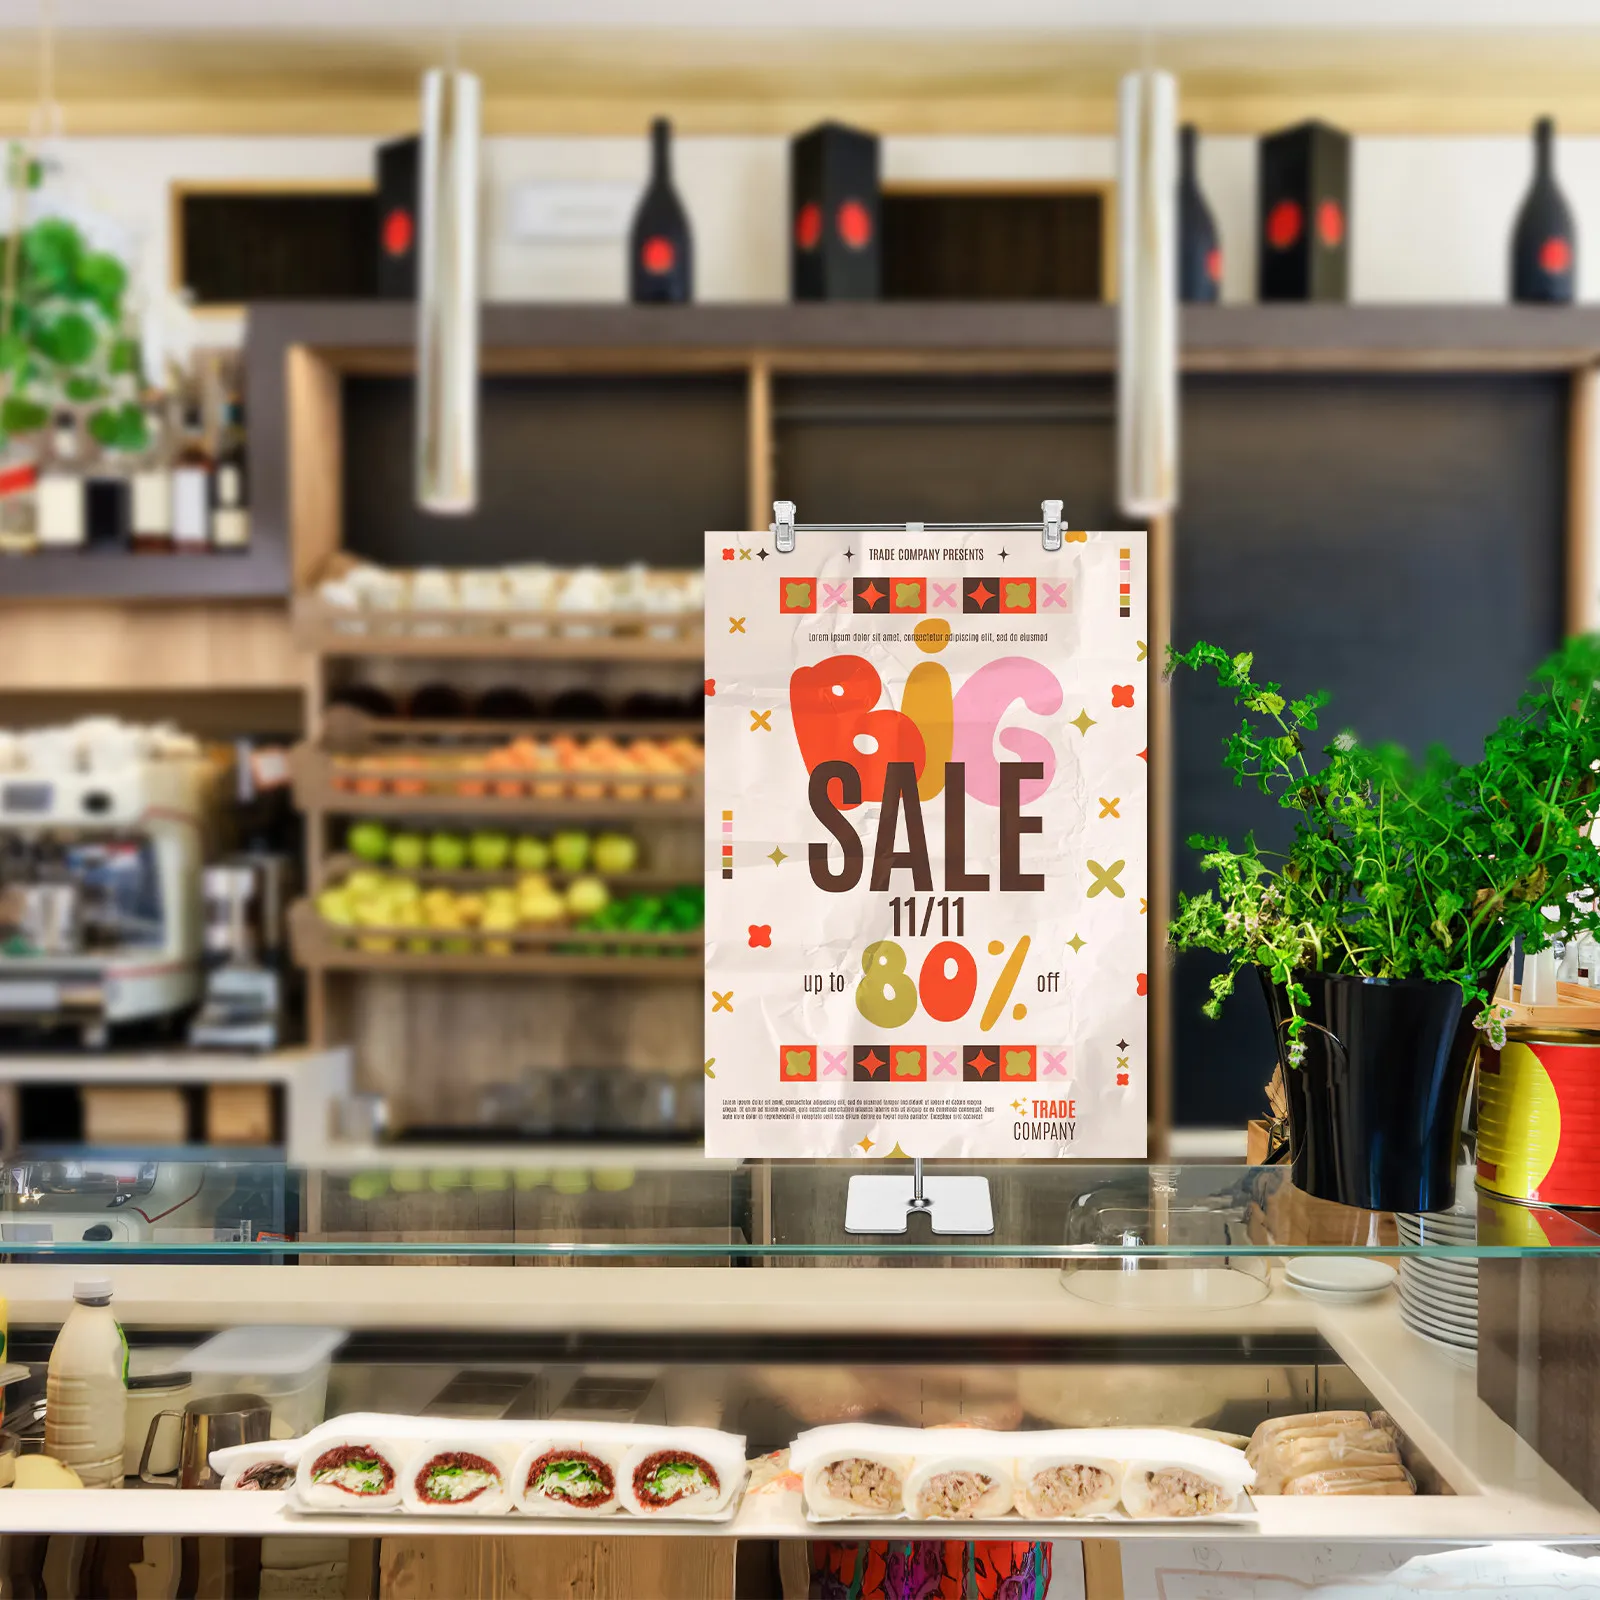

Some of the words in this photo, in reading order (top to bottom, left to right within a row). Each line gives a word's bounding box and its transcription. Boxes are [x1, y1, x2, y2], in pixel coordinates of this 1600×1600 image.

[868, 548, 895, 561] TRADE
[898, 548, 941, 561] COMPANY
[943, 548, 984, 561] PRESENTS
[808, 632, 829, 642] Lorem
[852, 632, 871, 642] dolor
[872, 632, 881, 642] sit
[882, 632, 902, 643] amet,
[903, 632, 943, 642] consectetur
[944, 632, 979, 643] adipiscing
[996, 632, 1008, 642] sed
[1009, 632, 1018, 642] do
[808, 760, 1045, 892] SALE
[889, 896, 964, 937] 11/11
[804, 974, 823, 995] up
[829, 972, 845, 993] to
[855, 935, 1031, 1032] 80%
[1037, 971, 1060, 993] off
[1031, 1100, 1076, 1119] TRADE
[1013, 1121, 1076, 1141] COMPANY
